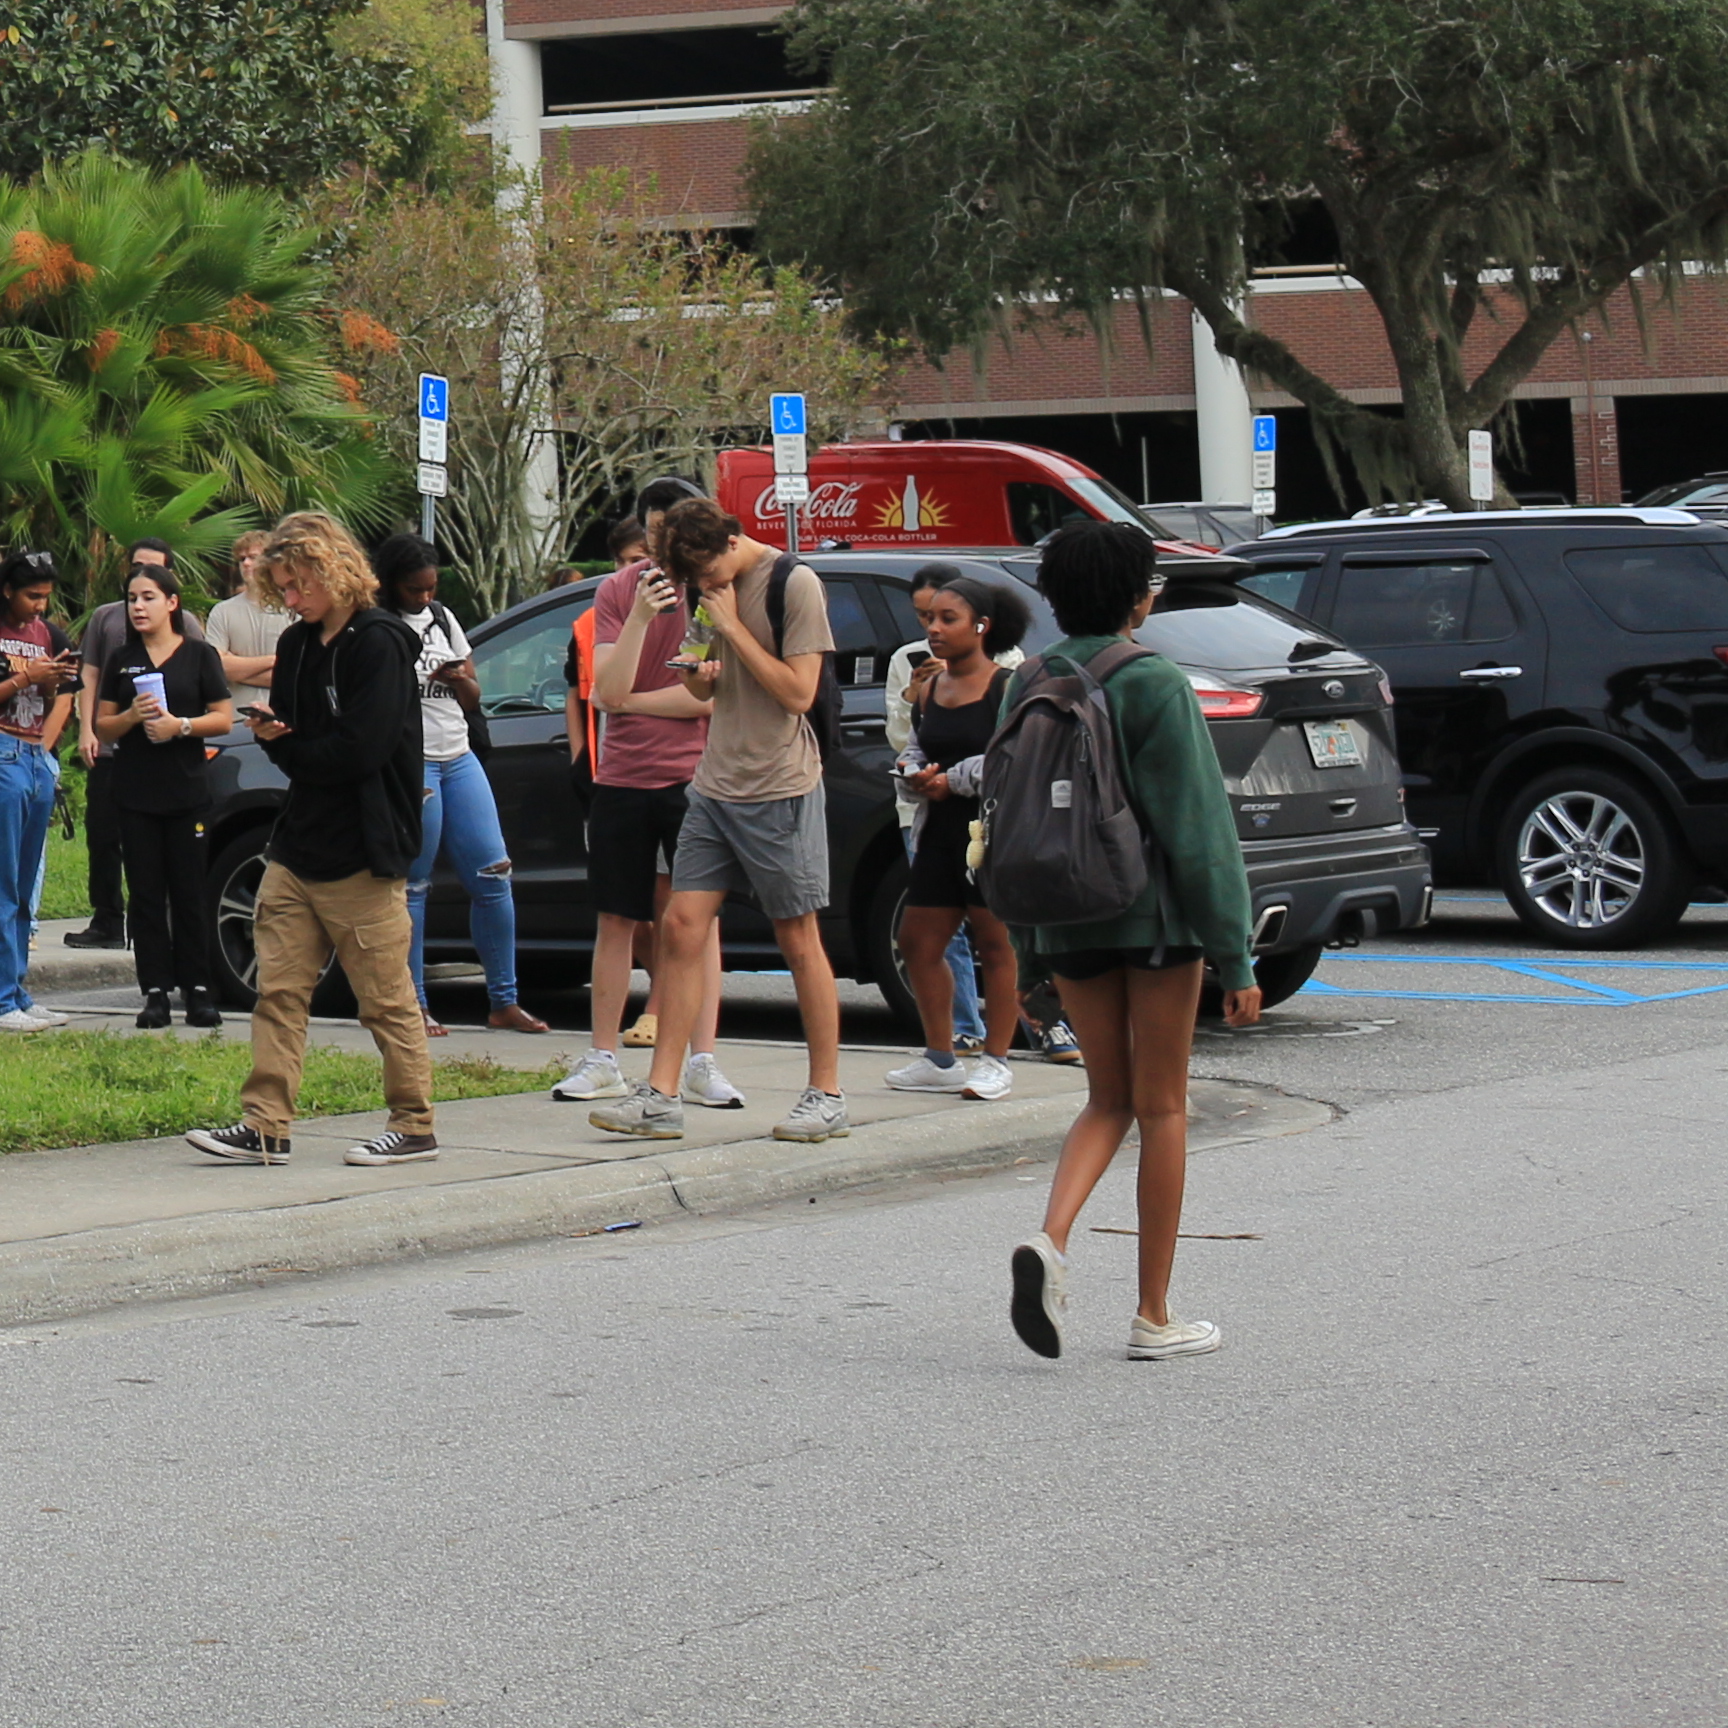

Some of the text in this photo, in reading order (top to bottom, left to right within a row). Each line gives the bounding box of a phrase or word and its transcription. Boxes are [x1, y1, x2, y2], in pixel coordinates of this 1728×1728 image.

[754, 481, 864, 520] CocCola
[816, 520, 857, 529] FLORIDA
[844, 533, 897, 542] COCA-COLA
[898, 533, 937, 541] BOTTLER
[1240, 802, 1281, 812] EDGE
